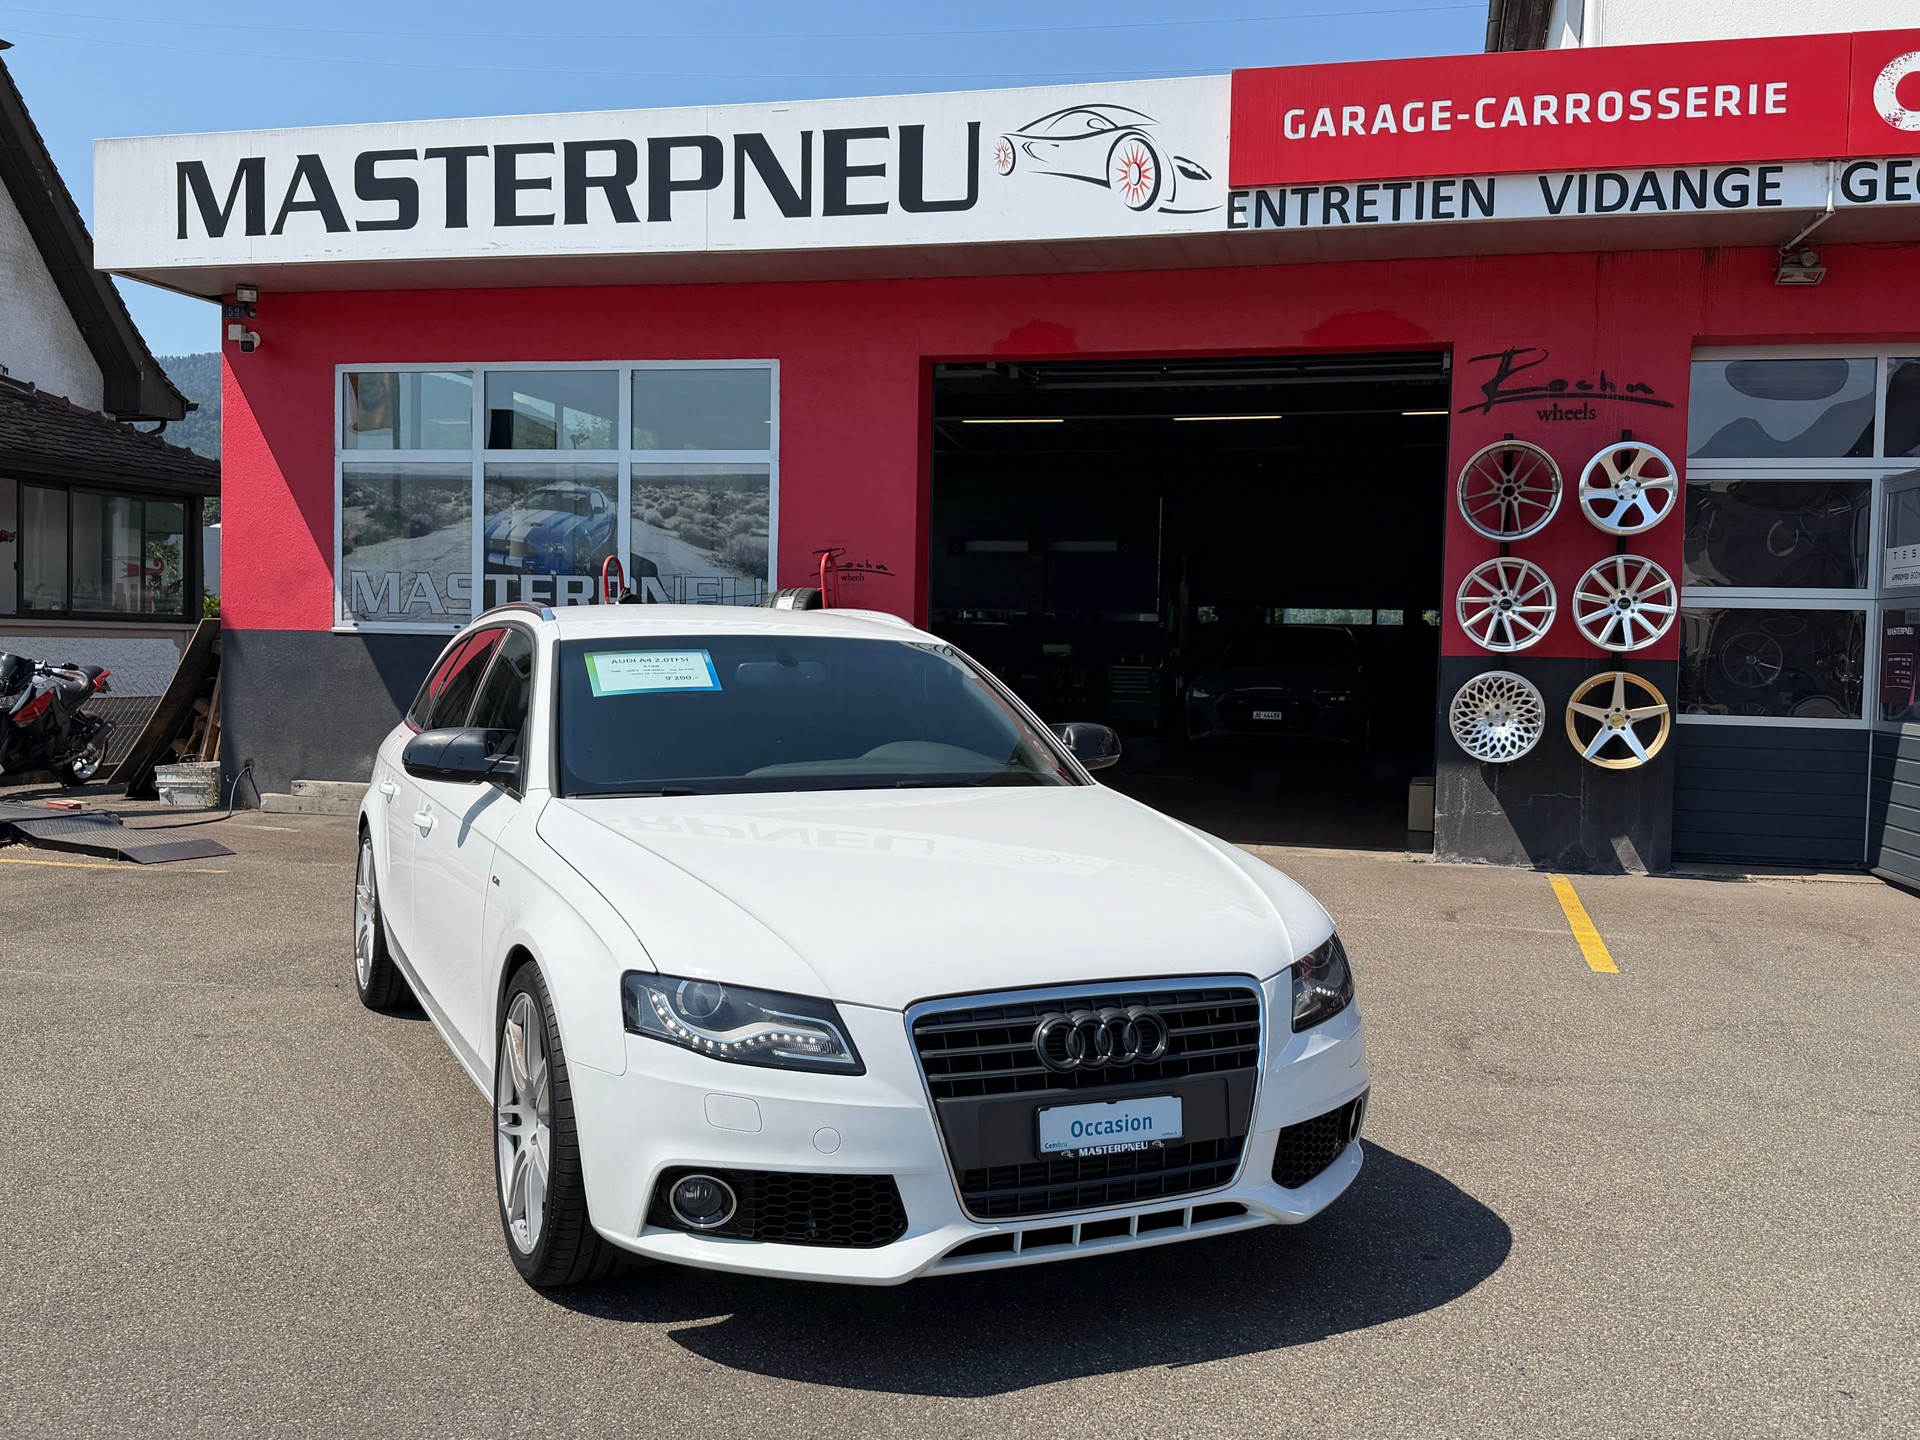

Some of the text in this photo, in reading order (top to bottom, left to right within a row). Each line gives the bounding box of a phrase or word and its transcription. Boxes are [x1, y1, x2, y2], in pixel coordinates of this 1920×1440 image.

[1283, 81, 1788, 140] GARAGE-CARROSSERIE
[176, 121, 981, 240] MASTERPNEU
[1228, 160, 1920, 230] ENTRETIEN VIDANGE GE
[1537, 402, 1597, 422] wheels
[841, 573, 865, 582] wheels
[1070, 1114, 1153, 1138] Occasion
[1044, 1141, 1068, 1149] Cembra
[1078, 1141, 1149, 1157] MASTERPNEU
